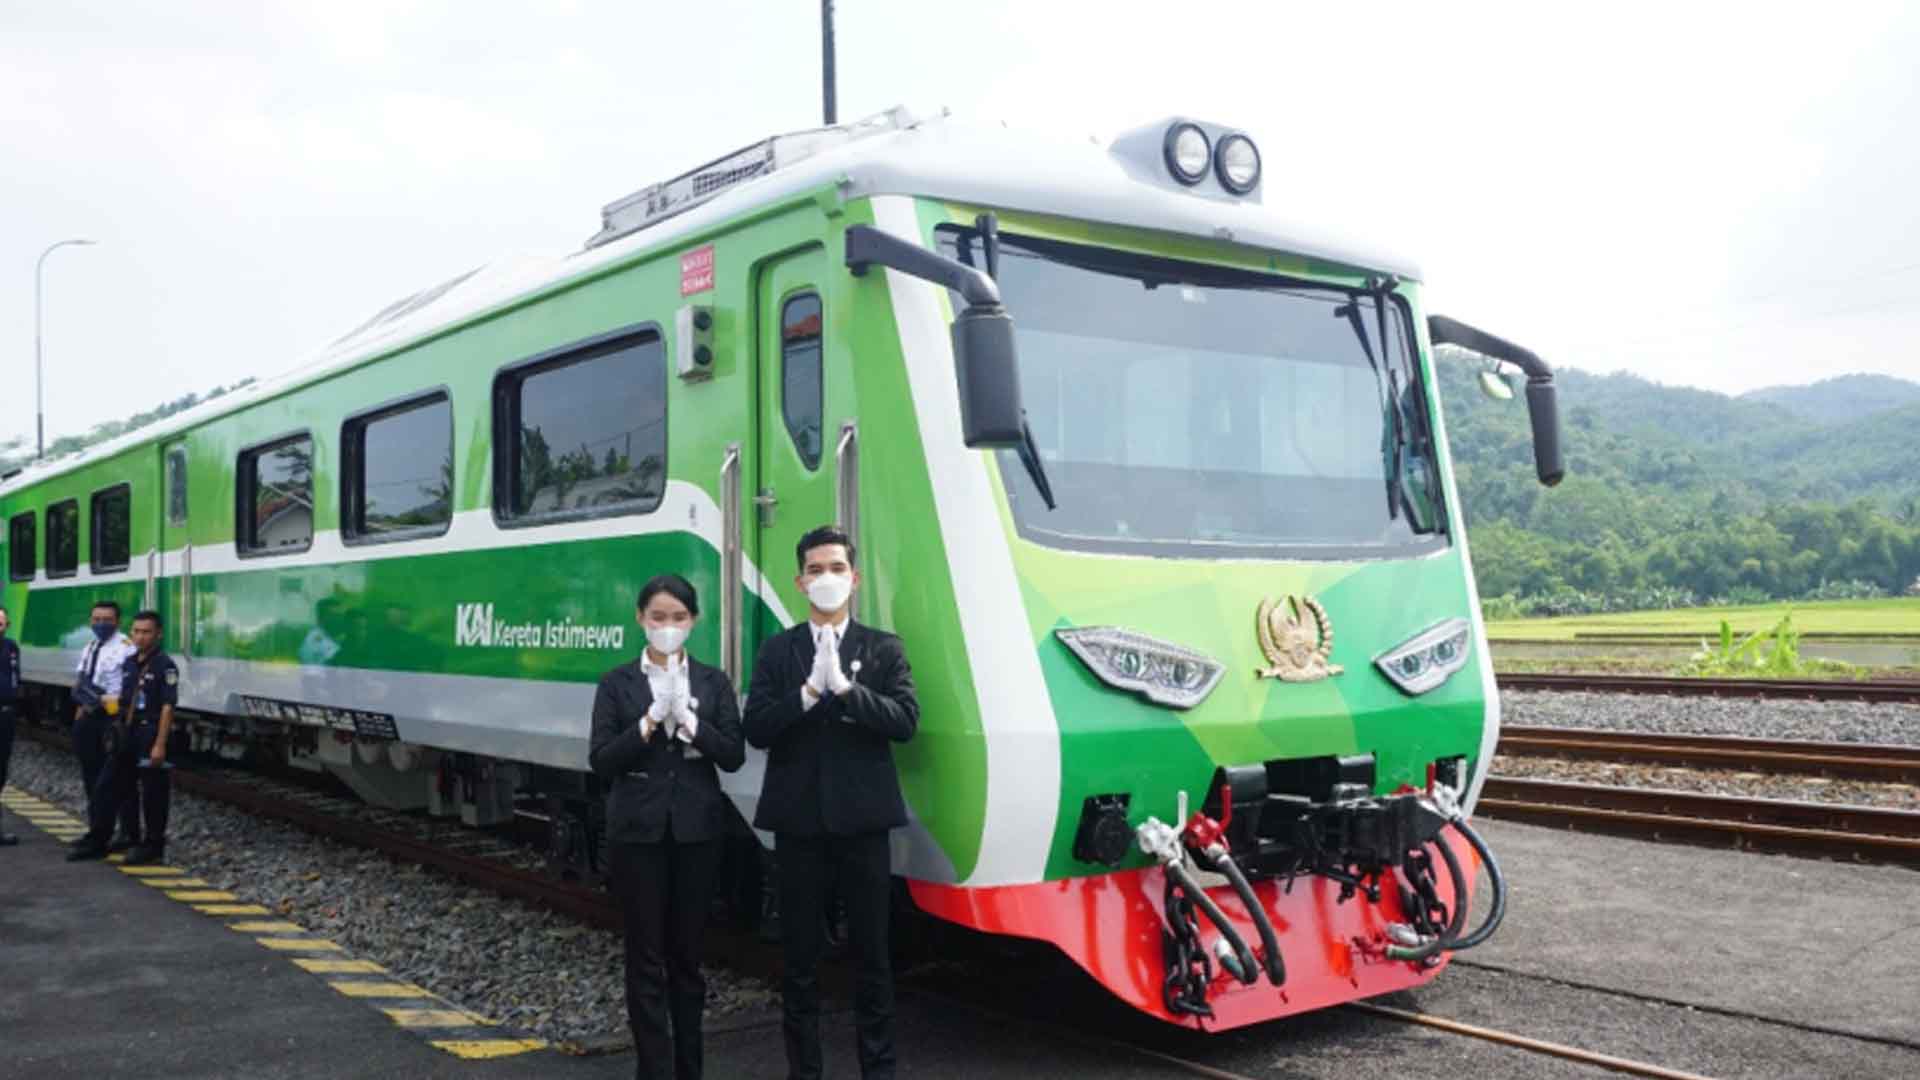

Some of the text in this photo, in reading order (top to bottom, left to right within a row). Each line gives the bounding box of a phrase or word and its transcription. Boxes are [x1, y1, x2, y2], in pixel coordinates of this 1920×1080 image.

[455, 602, 624, 649] KAI Kereta Istimewa
